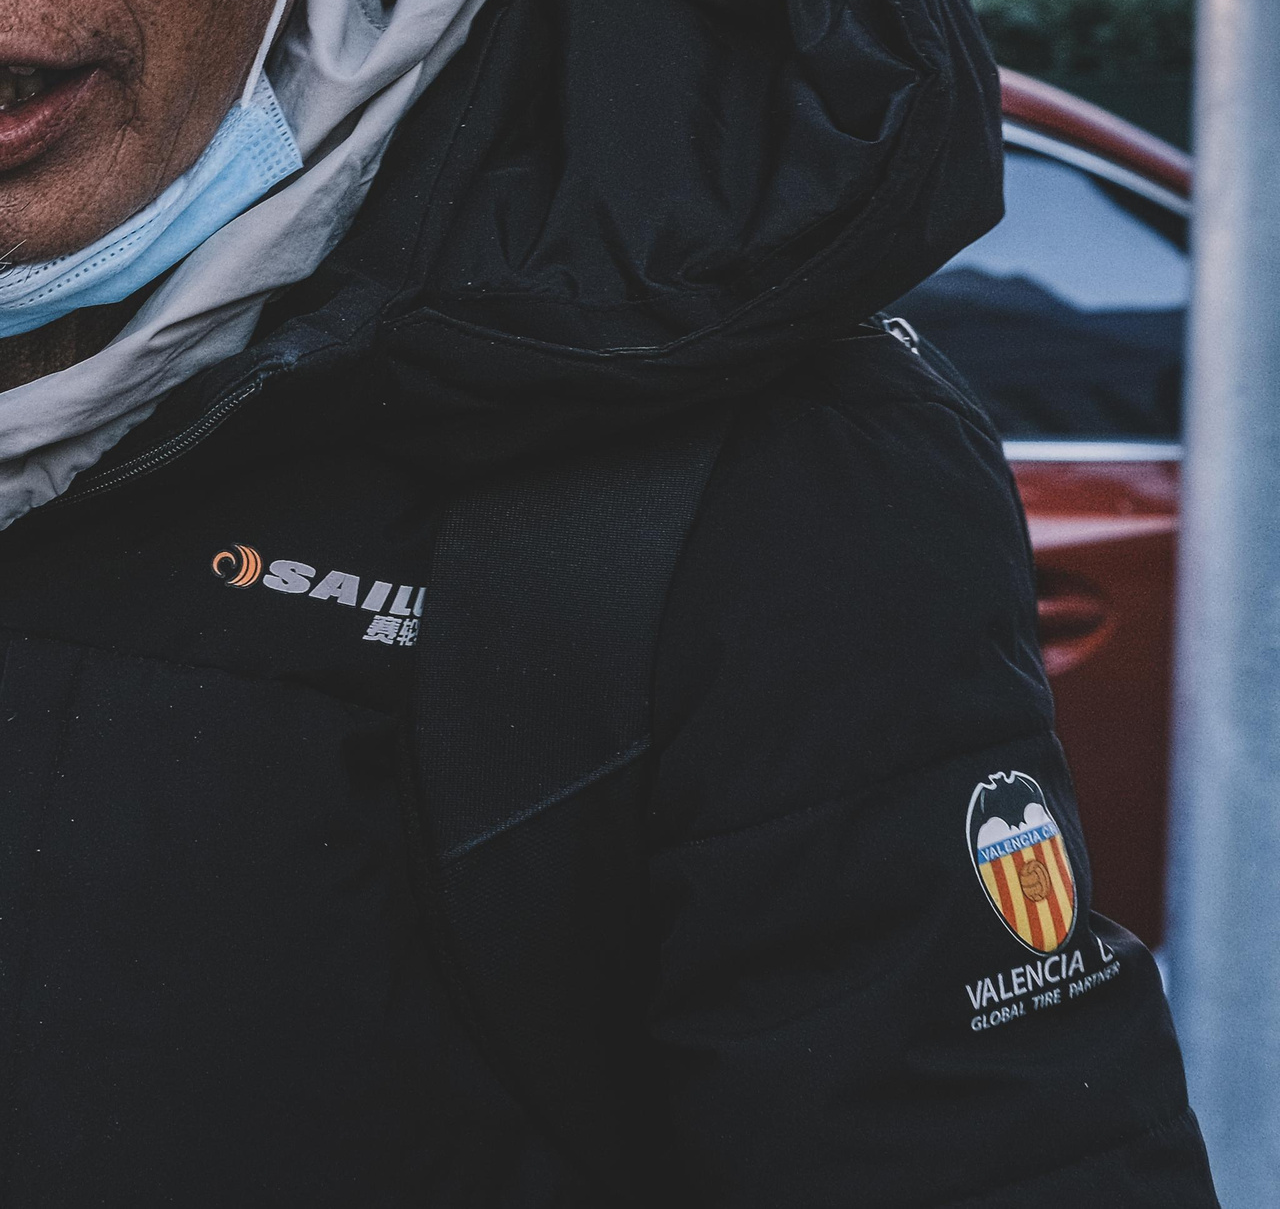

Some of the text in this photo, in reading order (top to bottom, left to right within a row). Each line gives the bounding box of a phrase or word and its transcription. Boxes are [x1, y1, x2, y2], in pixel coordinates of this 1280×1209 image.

[981, 829, 1042, 862] VALENCIA
[965, 949, 1085, 1010] VALENCIA
[970, 1001, 1026, 1031] GLOBAL
[1031, 988, 1062, 1010] TIRE
